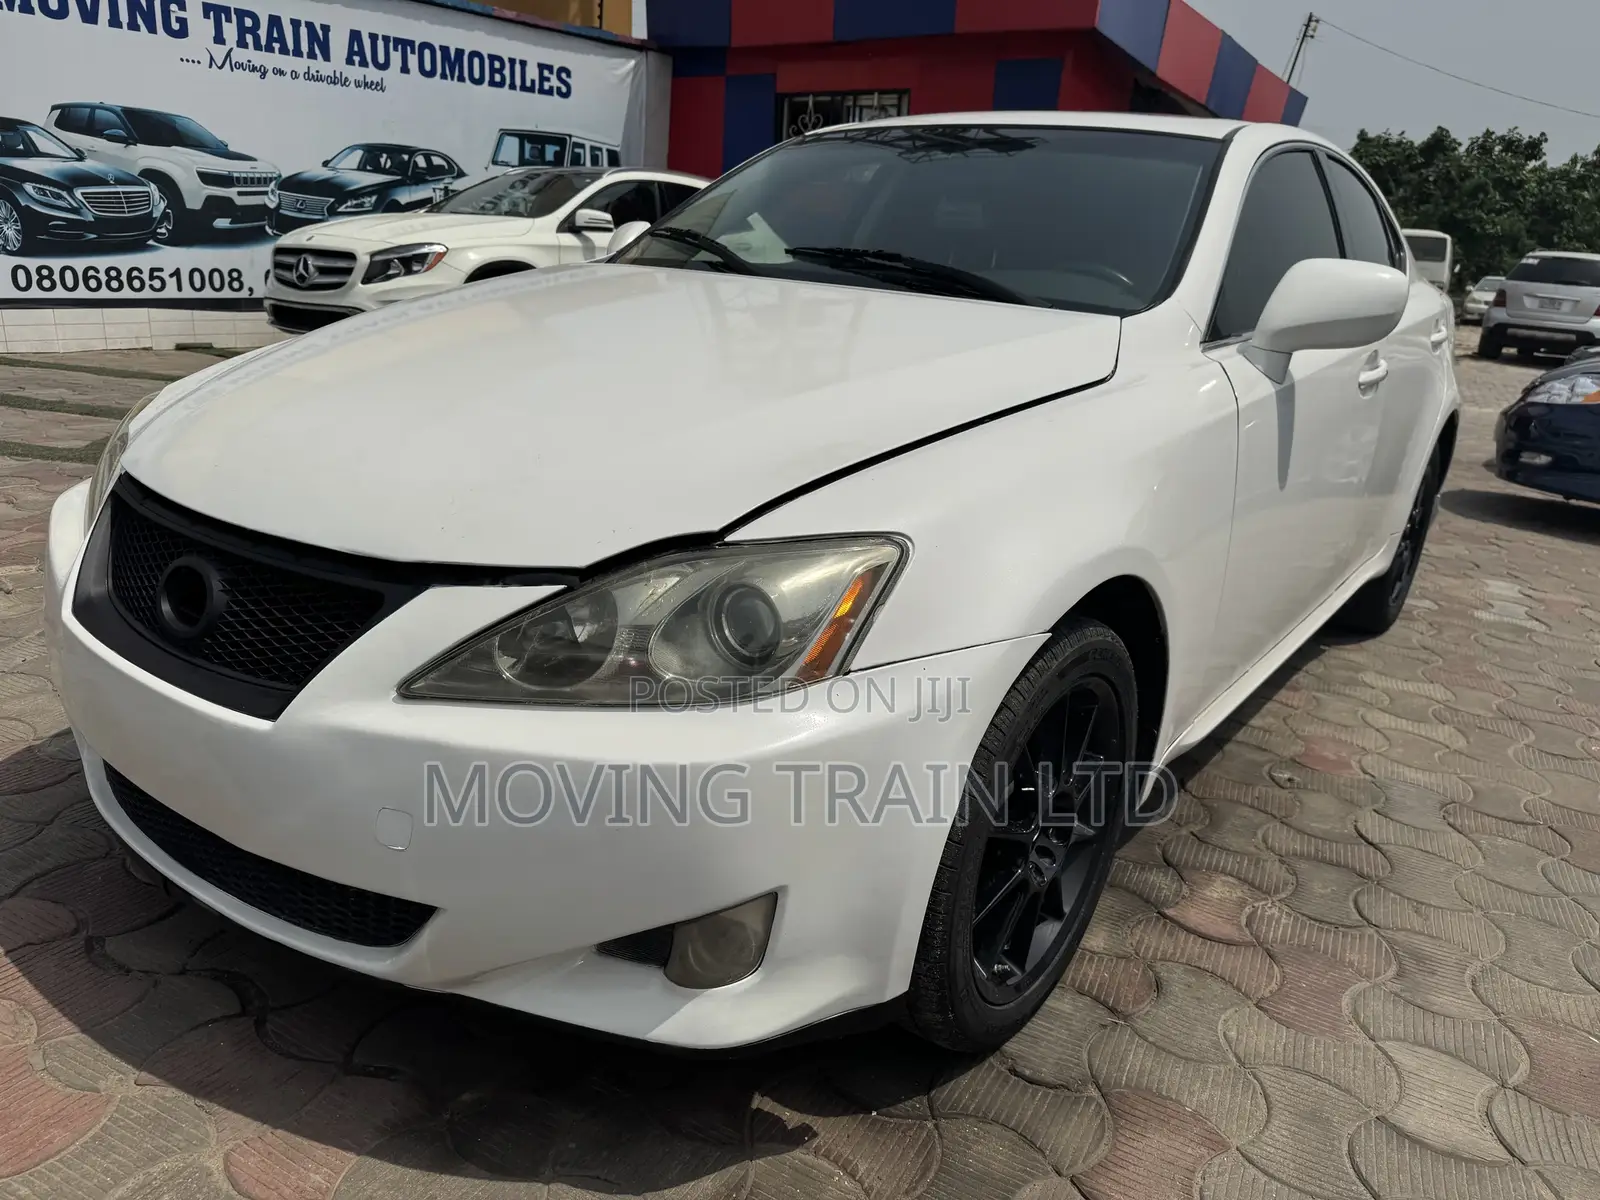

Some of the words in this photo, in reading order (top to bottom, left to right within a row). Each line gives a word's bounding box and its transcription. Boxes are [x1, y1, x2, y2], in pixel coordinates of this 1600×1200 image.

[0, 0, 189, 39] VING
[201, 1, 331, 63] TRAIN
[345, 28, 572, 99] AUTOMOBILES
[272, 66, 287, 76] on
[290, 69, 300, 80] a
[303, 66, 351, 88] drivable
[354, 77, 386, 93] wheel
[10, 264, 254, 297] 08068651008,
